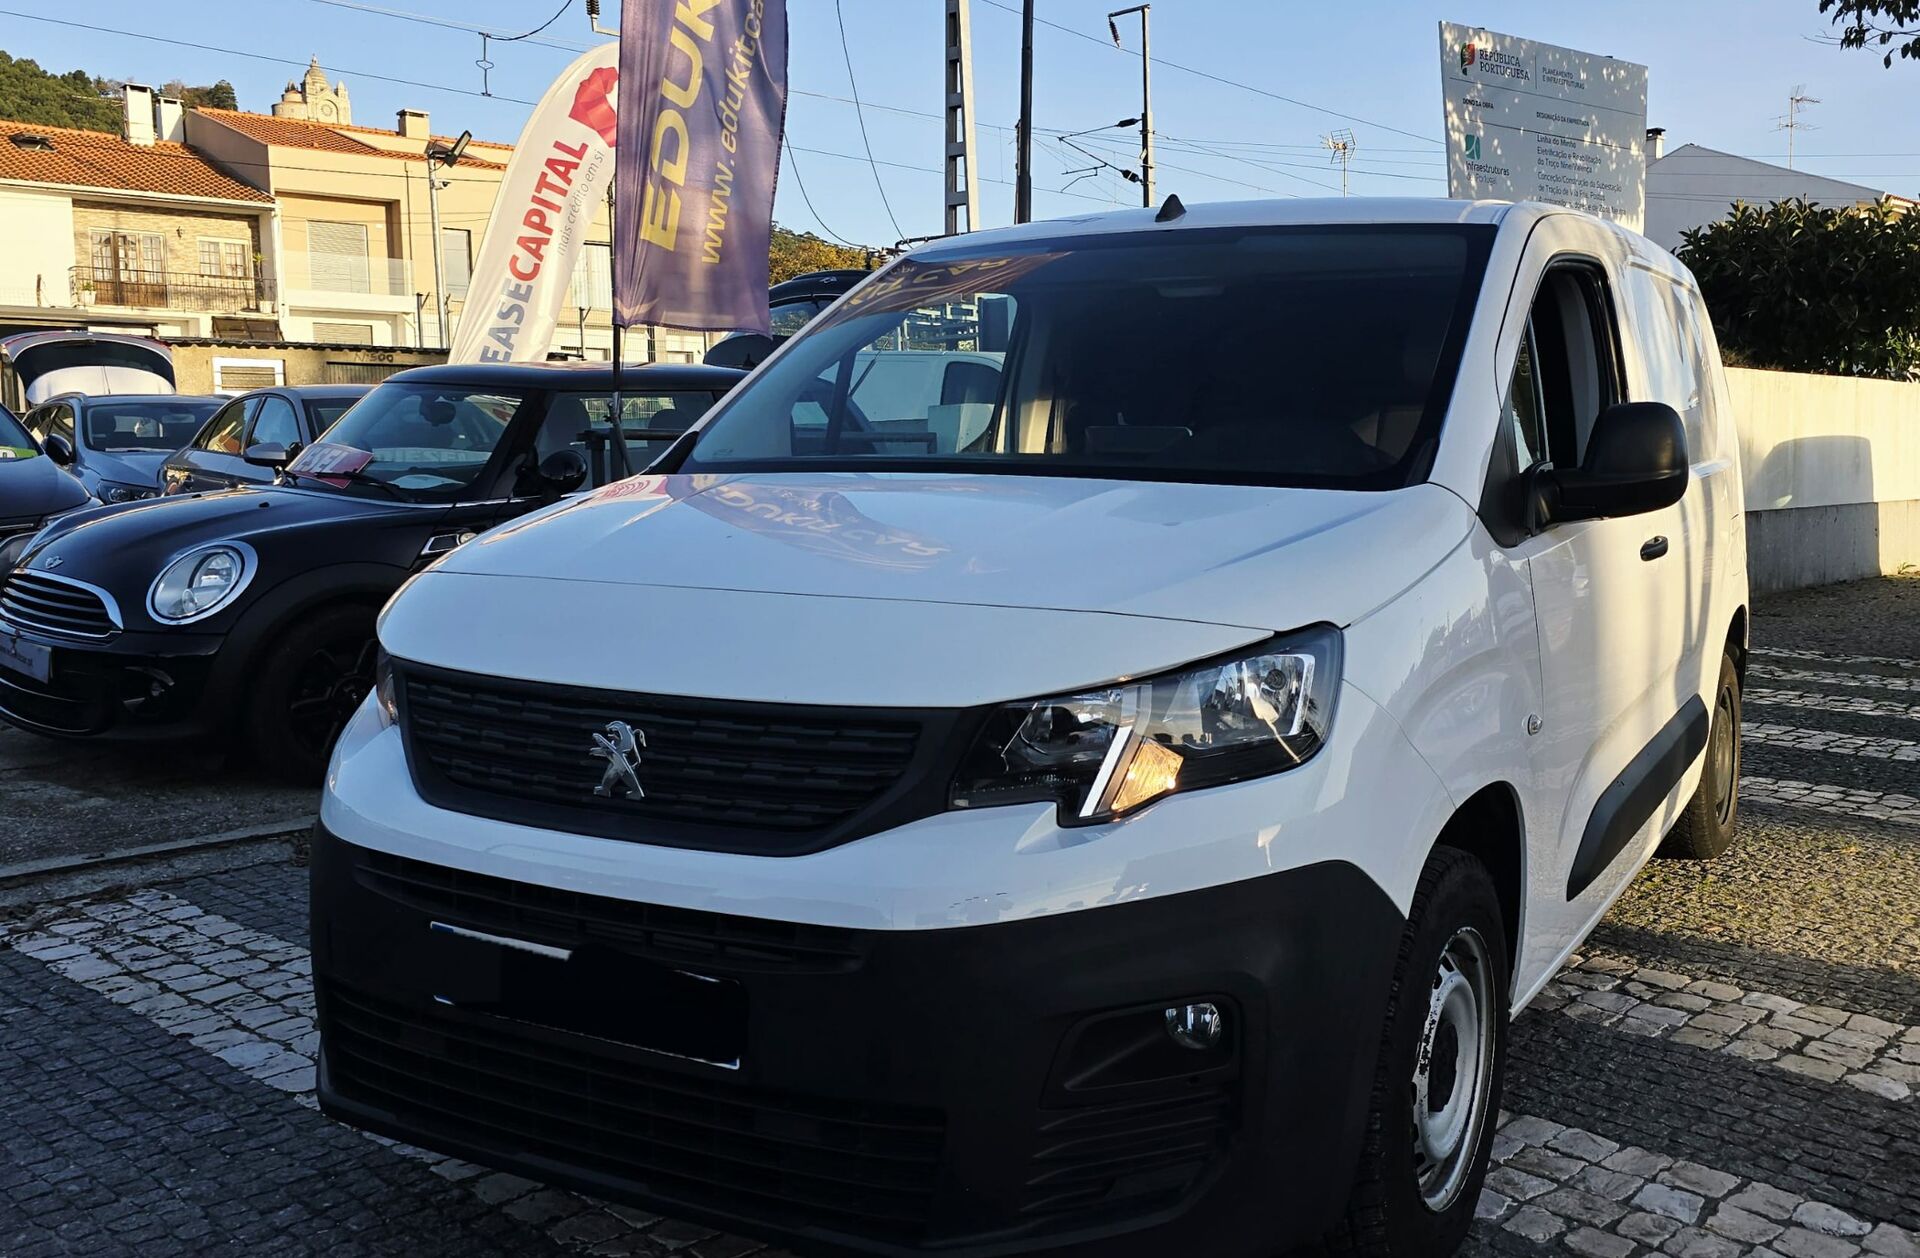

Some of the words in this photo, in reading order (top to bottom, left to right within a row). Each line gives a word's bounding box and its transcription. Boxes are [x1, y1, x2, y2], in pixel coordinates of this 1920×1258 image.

[1479, 49, 1521, 67] REPÚBLICA
[1480, 61, 1530, 81] PORTUGUESA
[1466, 161, 1510, 176] Infraestruturas
[557, 225, 573, 256] mais
[585, 162, 599, 183] em
[594, 149, 605, 164] si
